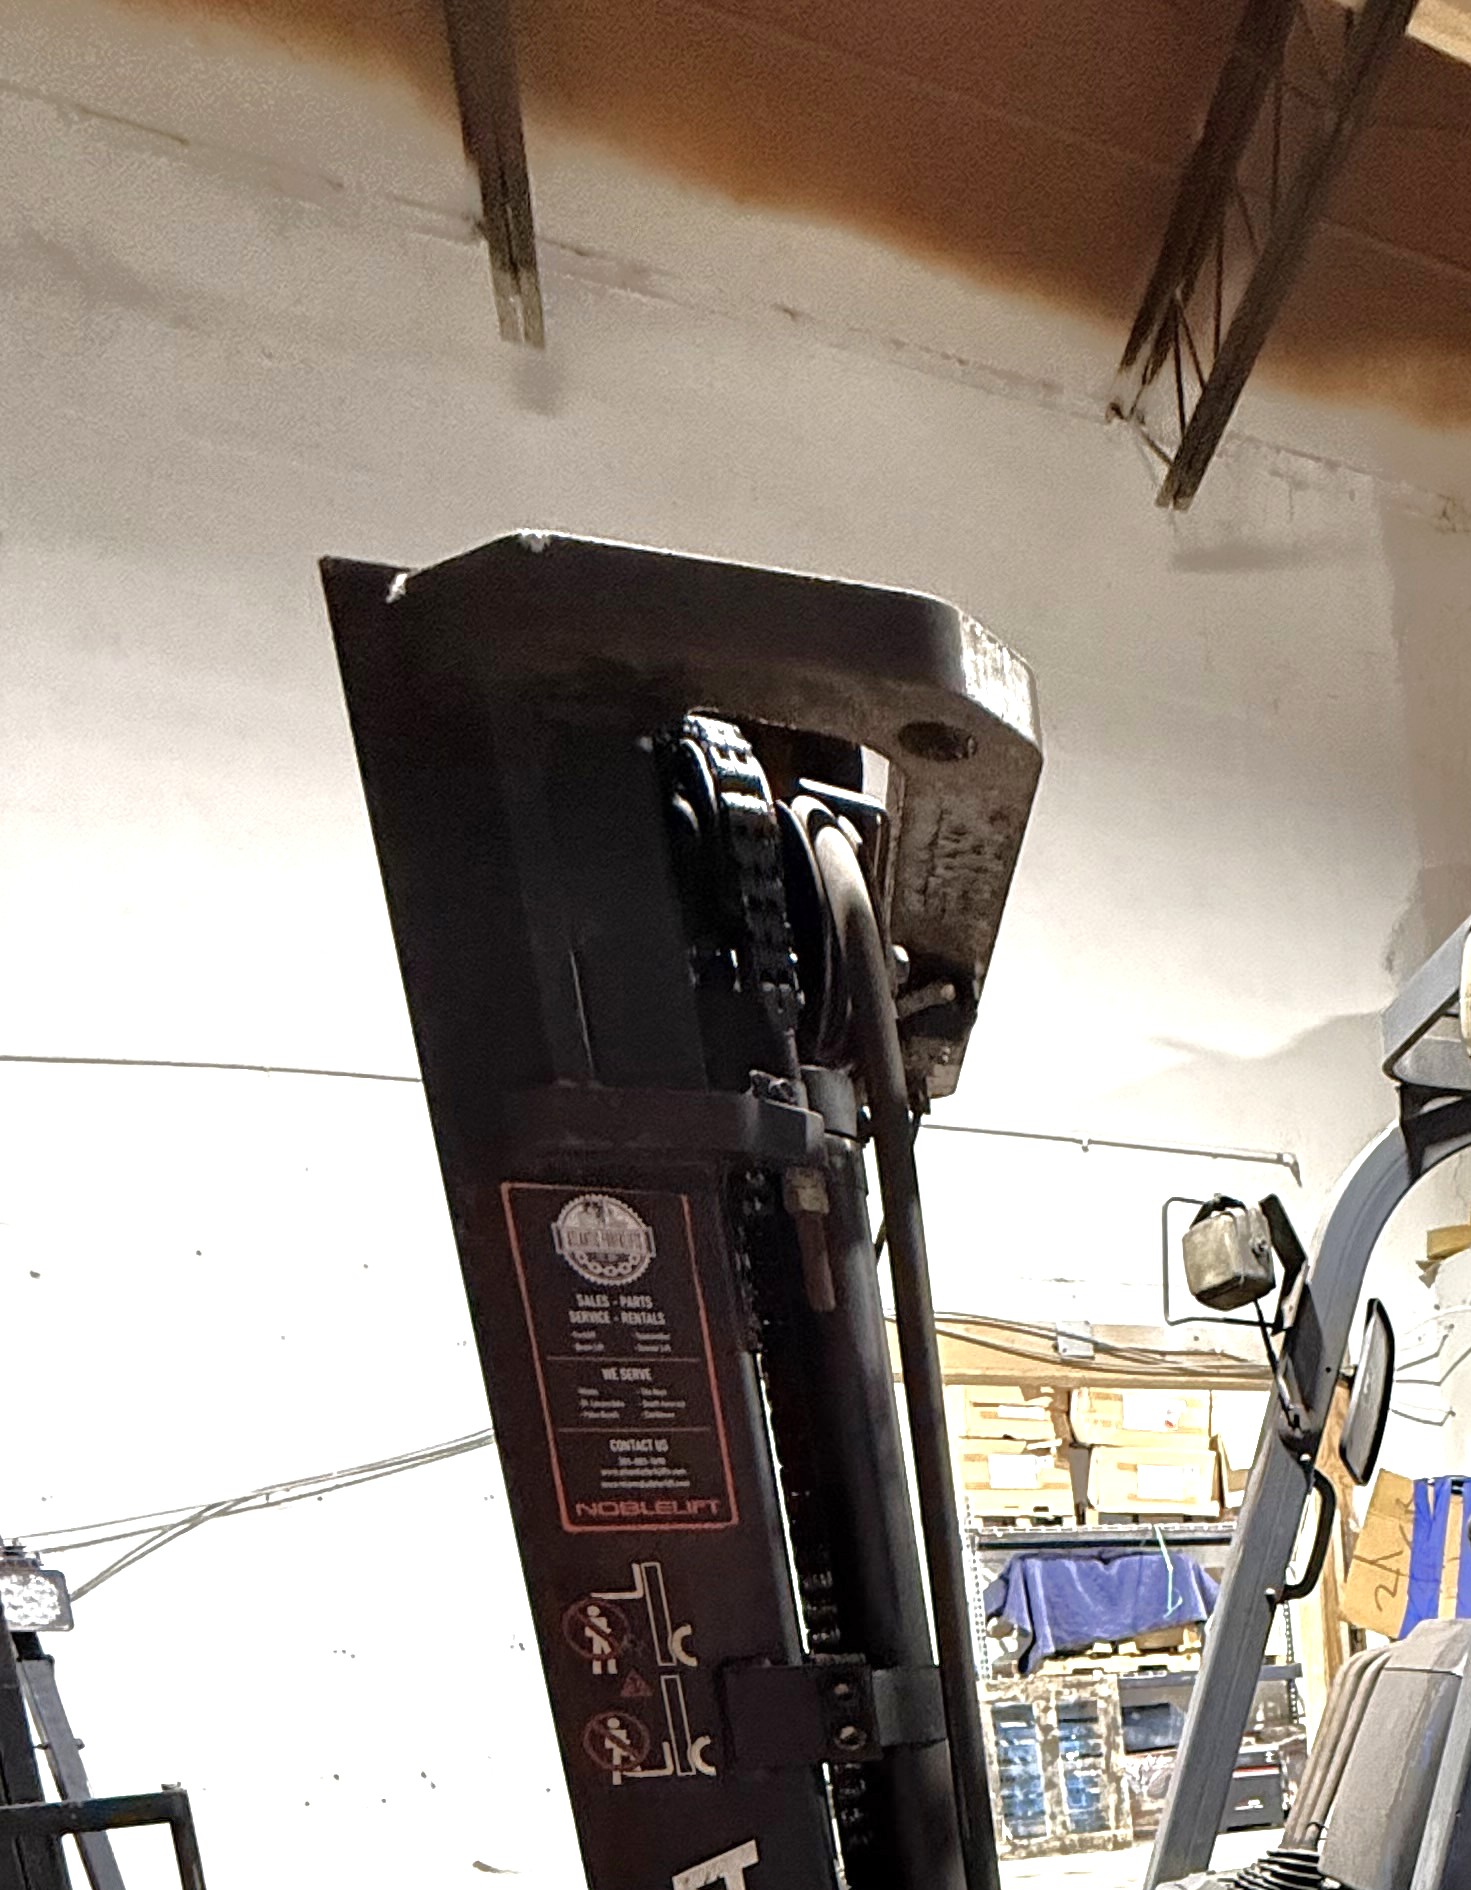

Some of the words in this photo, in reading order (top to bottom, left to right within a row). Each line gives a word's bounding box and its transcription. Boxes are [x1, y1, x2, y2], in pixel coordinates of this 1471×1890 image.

[576, 1294, 611, 1308] SALES
[619, 1295, 653, 1309] PARTS
[568, 1310, 611, 1324] SERVICE
[620, 1310, 666, 1326] RENTALS
[601, 1367, 619, 1381] WE
[620, 1367, 653, 1382] SERVE
[609, 1438, 654, 1453] CONTACT
[654, 1438, 669, 1453] US
[575, 1499, 720, 1517] NOBLELIFT
